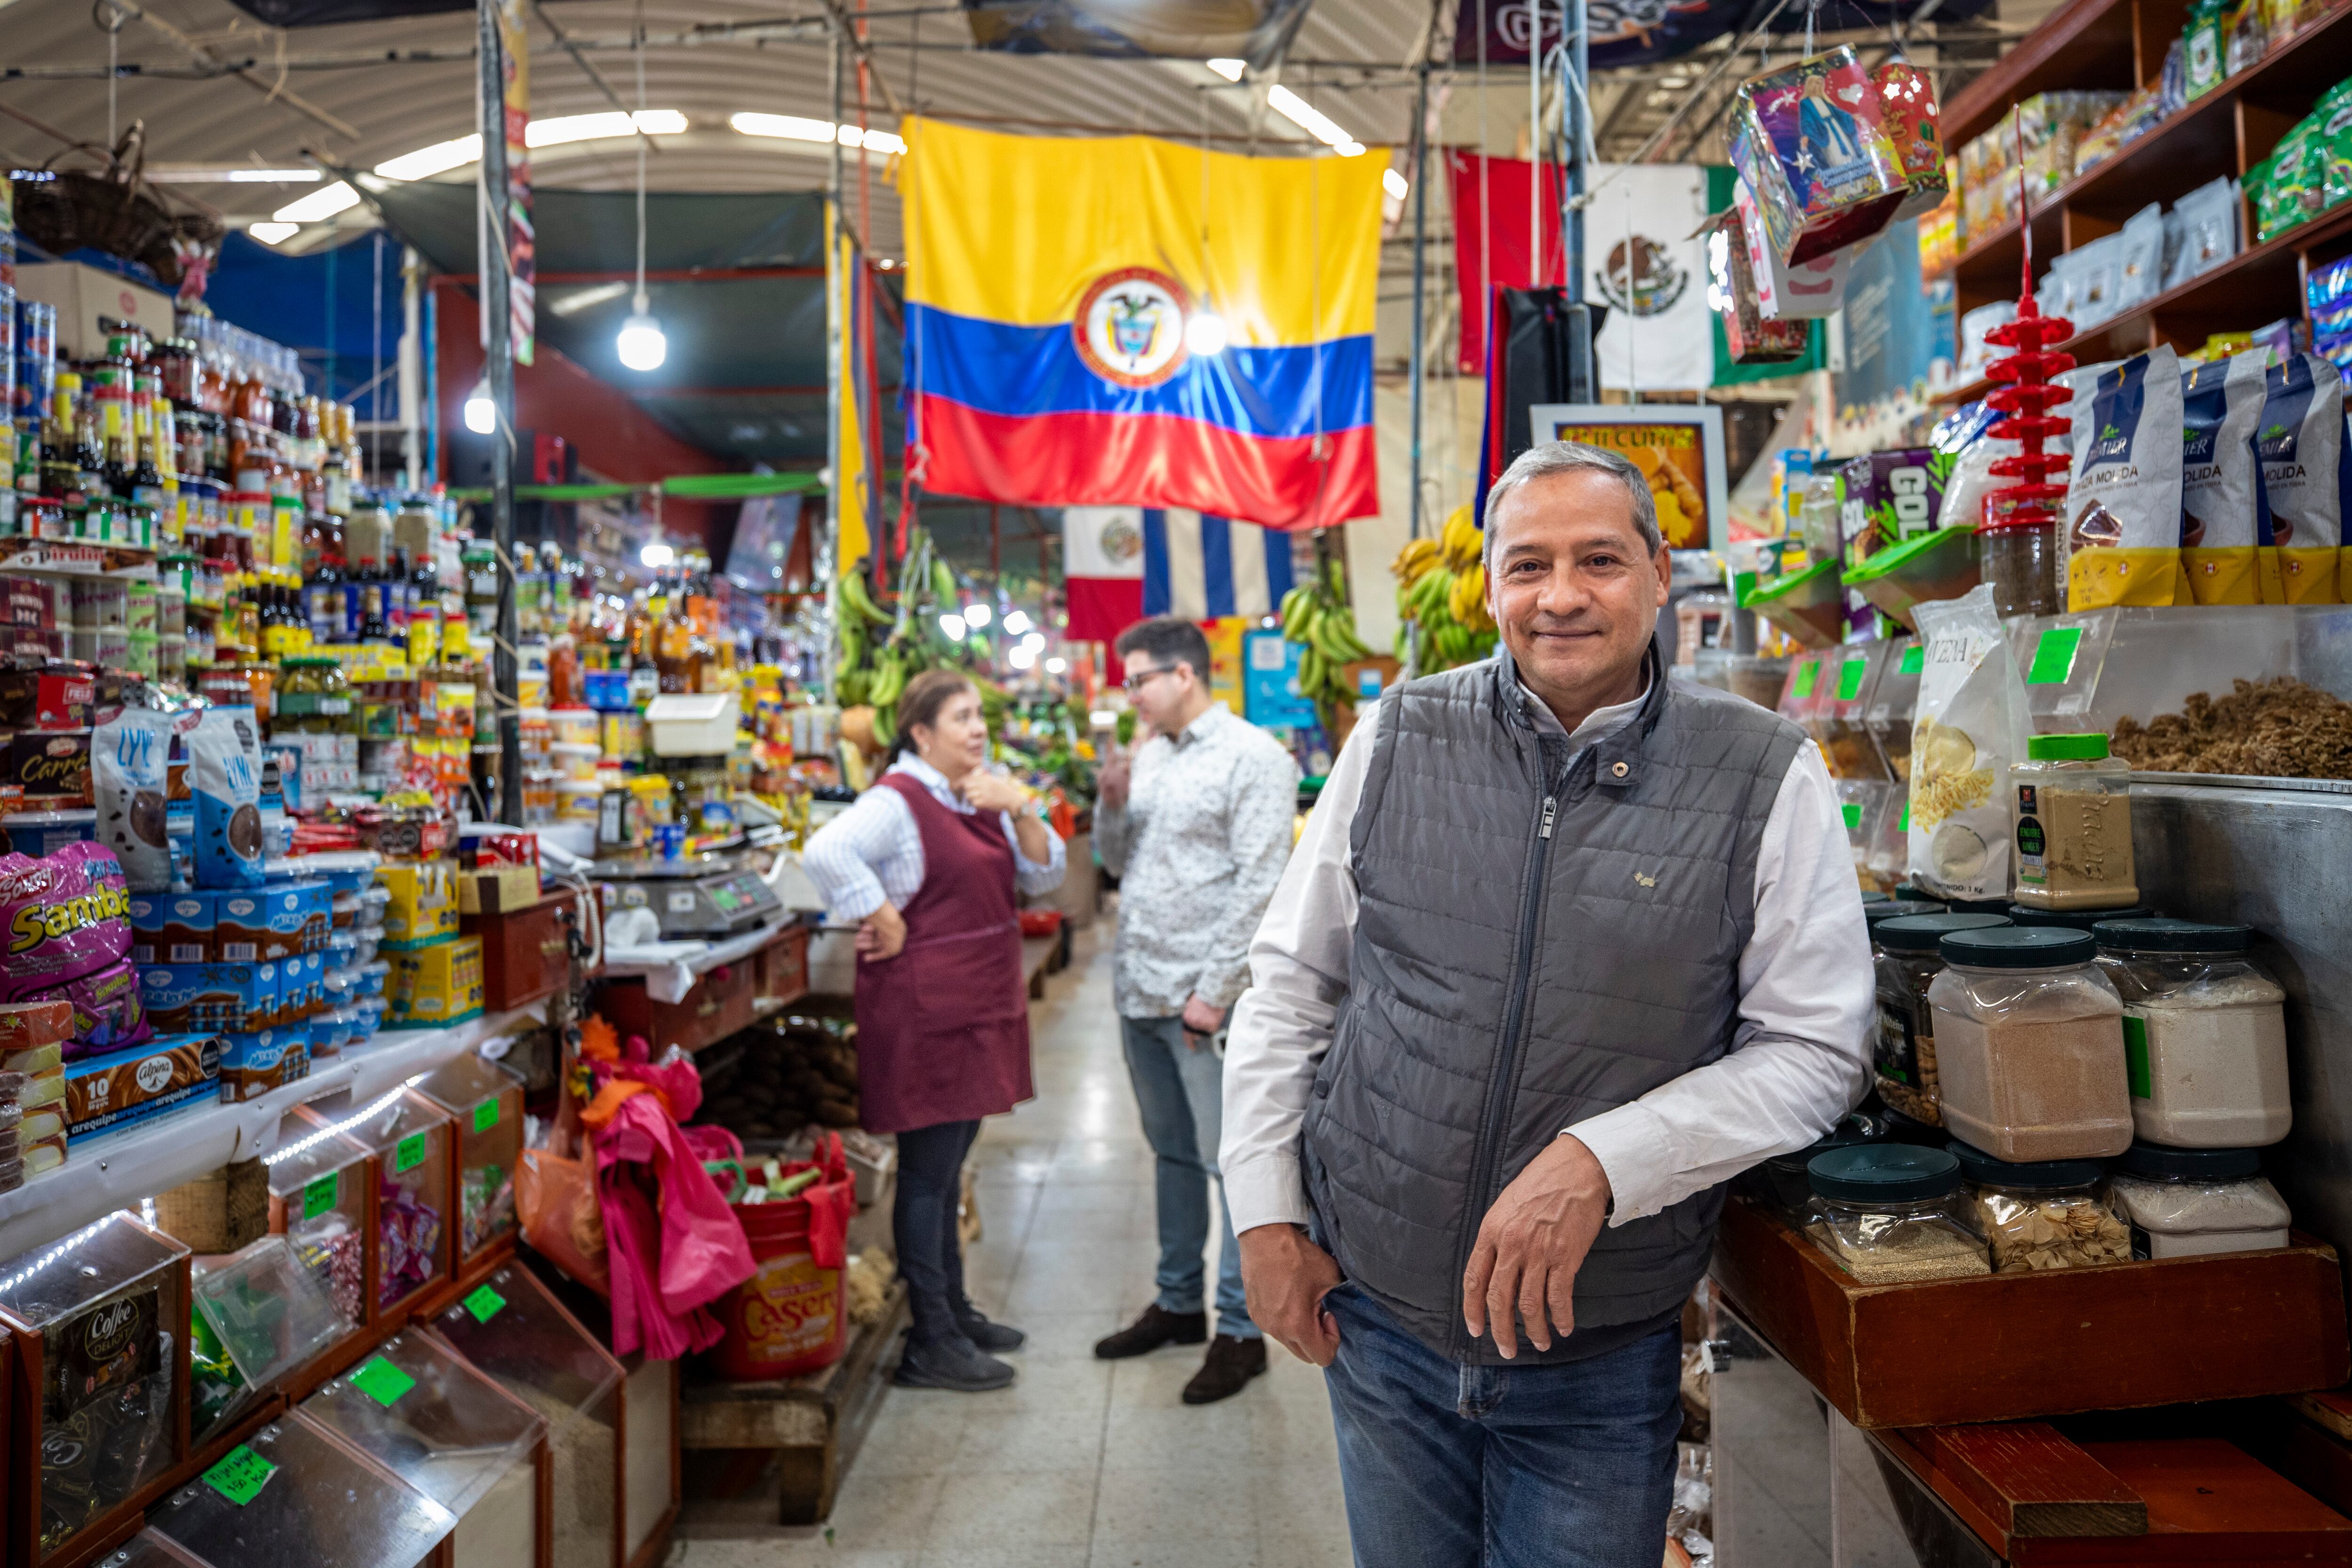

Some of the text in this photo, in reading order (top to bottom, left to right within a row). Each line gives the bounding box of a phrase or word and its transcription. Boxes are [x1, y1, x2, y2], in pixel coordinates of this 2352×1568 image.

[8, 882, 131, 956] Samba
[139, 1059, 170, 1081] alpina
[87, 1077, 109, 1100] 10
[72, 1112, 117, 1135] arequipe
[92, 1299, 131, 1339] Coffee
